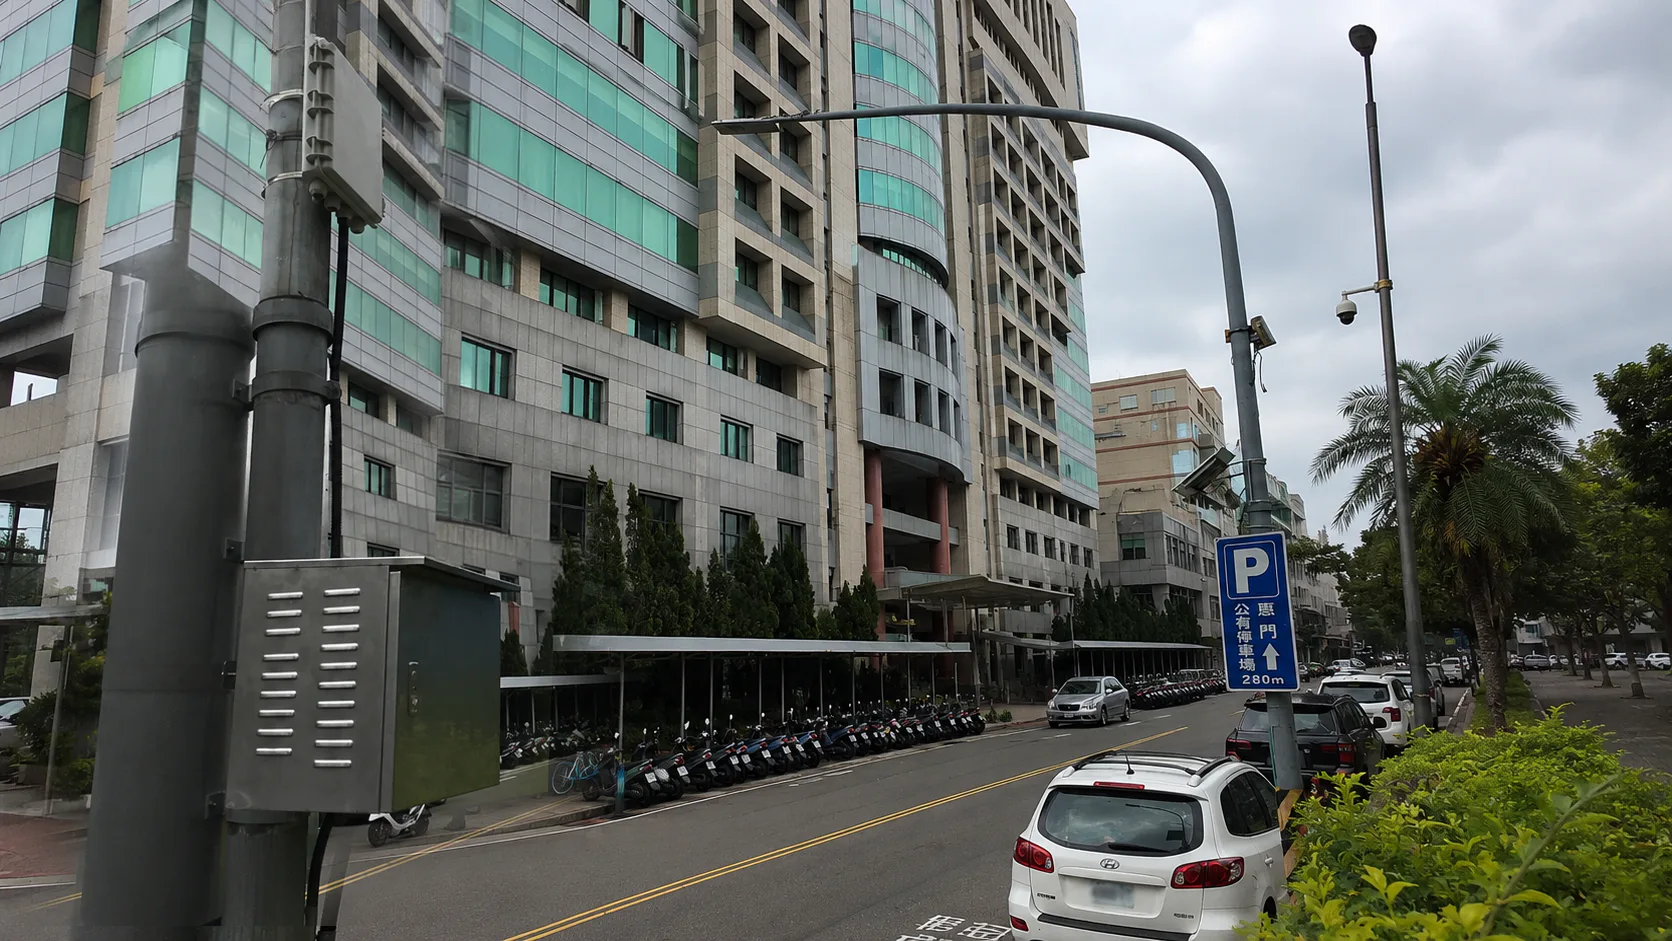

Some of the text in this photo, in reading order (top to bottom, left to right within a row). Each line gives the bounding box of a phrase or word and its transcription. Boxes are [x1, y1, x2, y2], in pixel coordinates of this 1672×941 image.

[1233, 547, 1270, 594] P
[1234, 603, 1256, 672] 公有停車場
[1242, 674, 1285, 685] 280m
